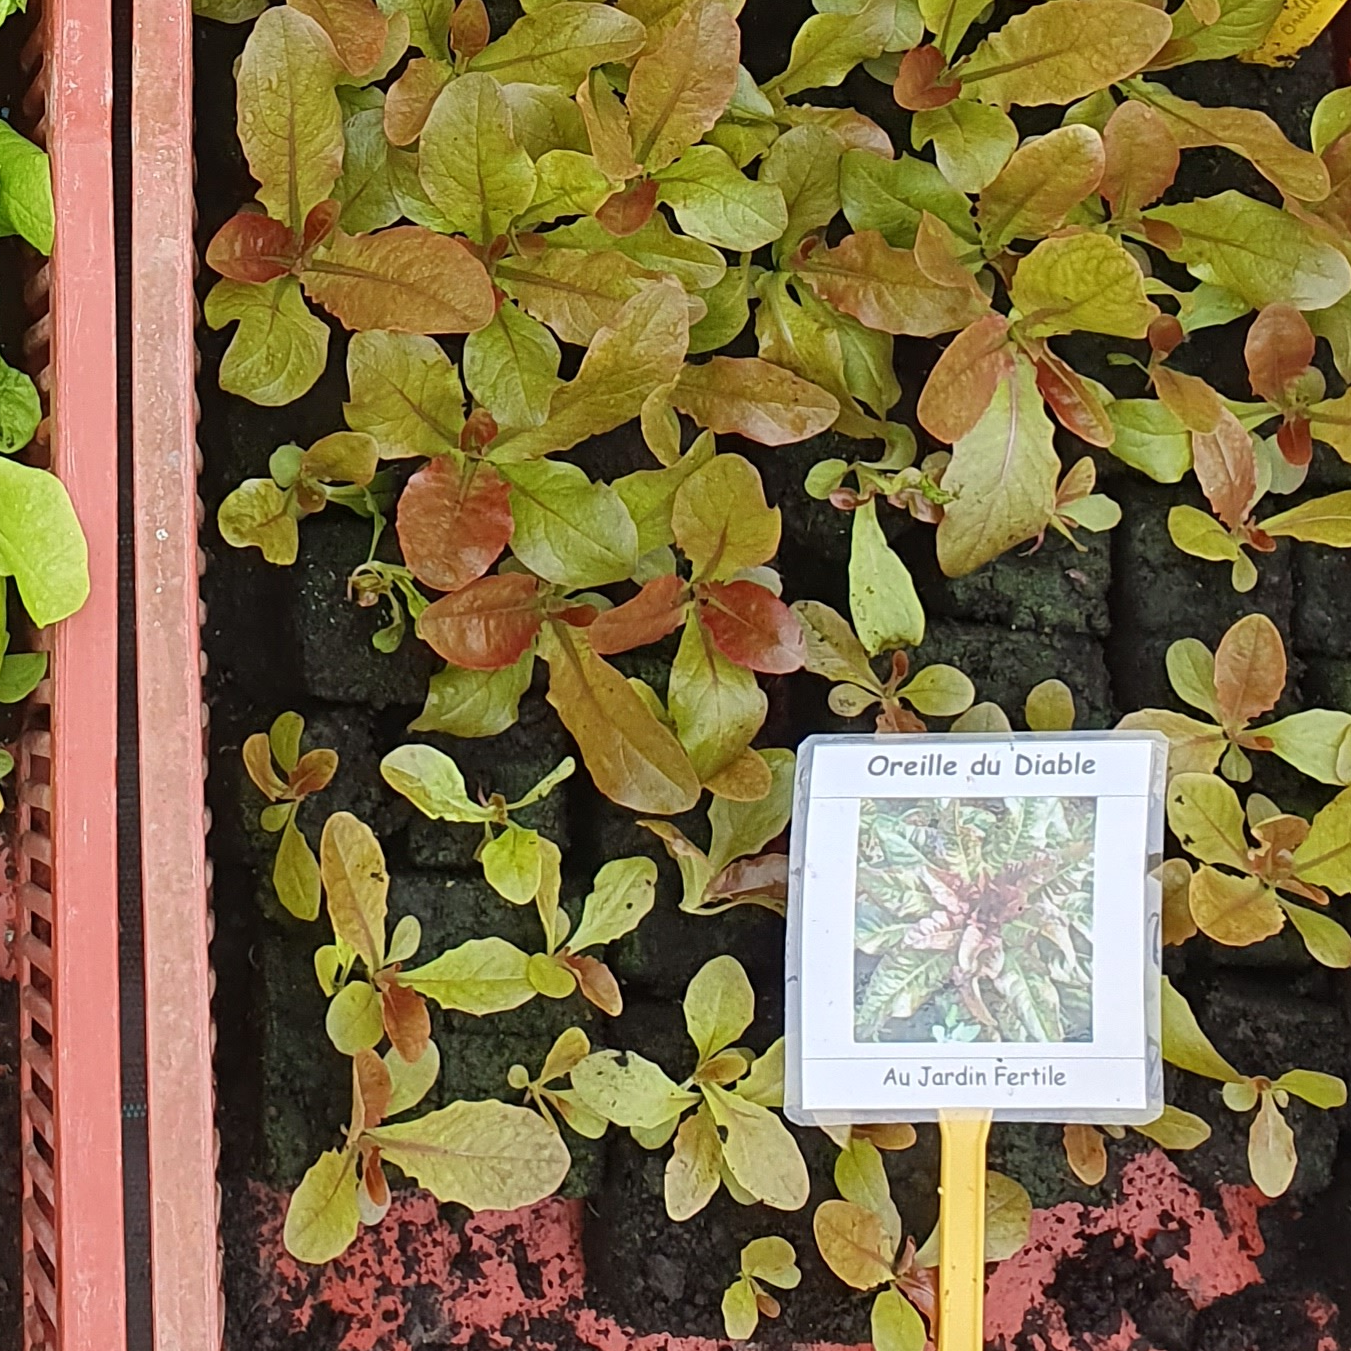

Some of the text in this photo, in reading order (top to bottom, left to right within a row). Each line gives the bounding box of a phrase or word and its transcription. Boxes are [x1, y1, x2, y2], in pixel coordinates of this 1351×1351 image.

[866, 752, 1096, 777] Oreille du Diable
[883, 1065, 1067, 1087] Au Jardin Fertile
